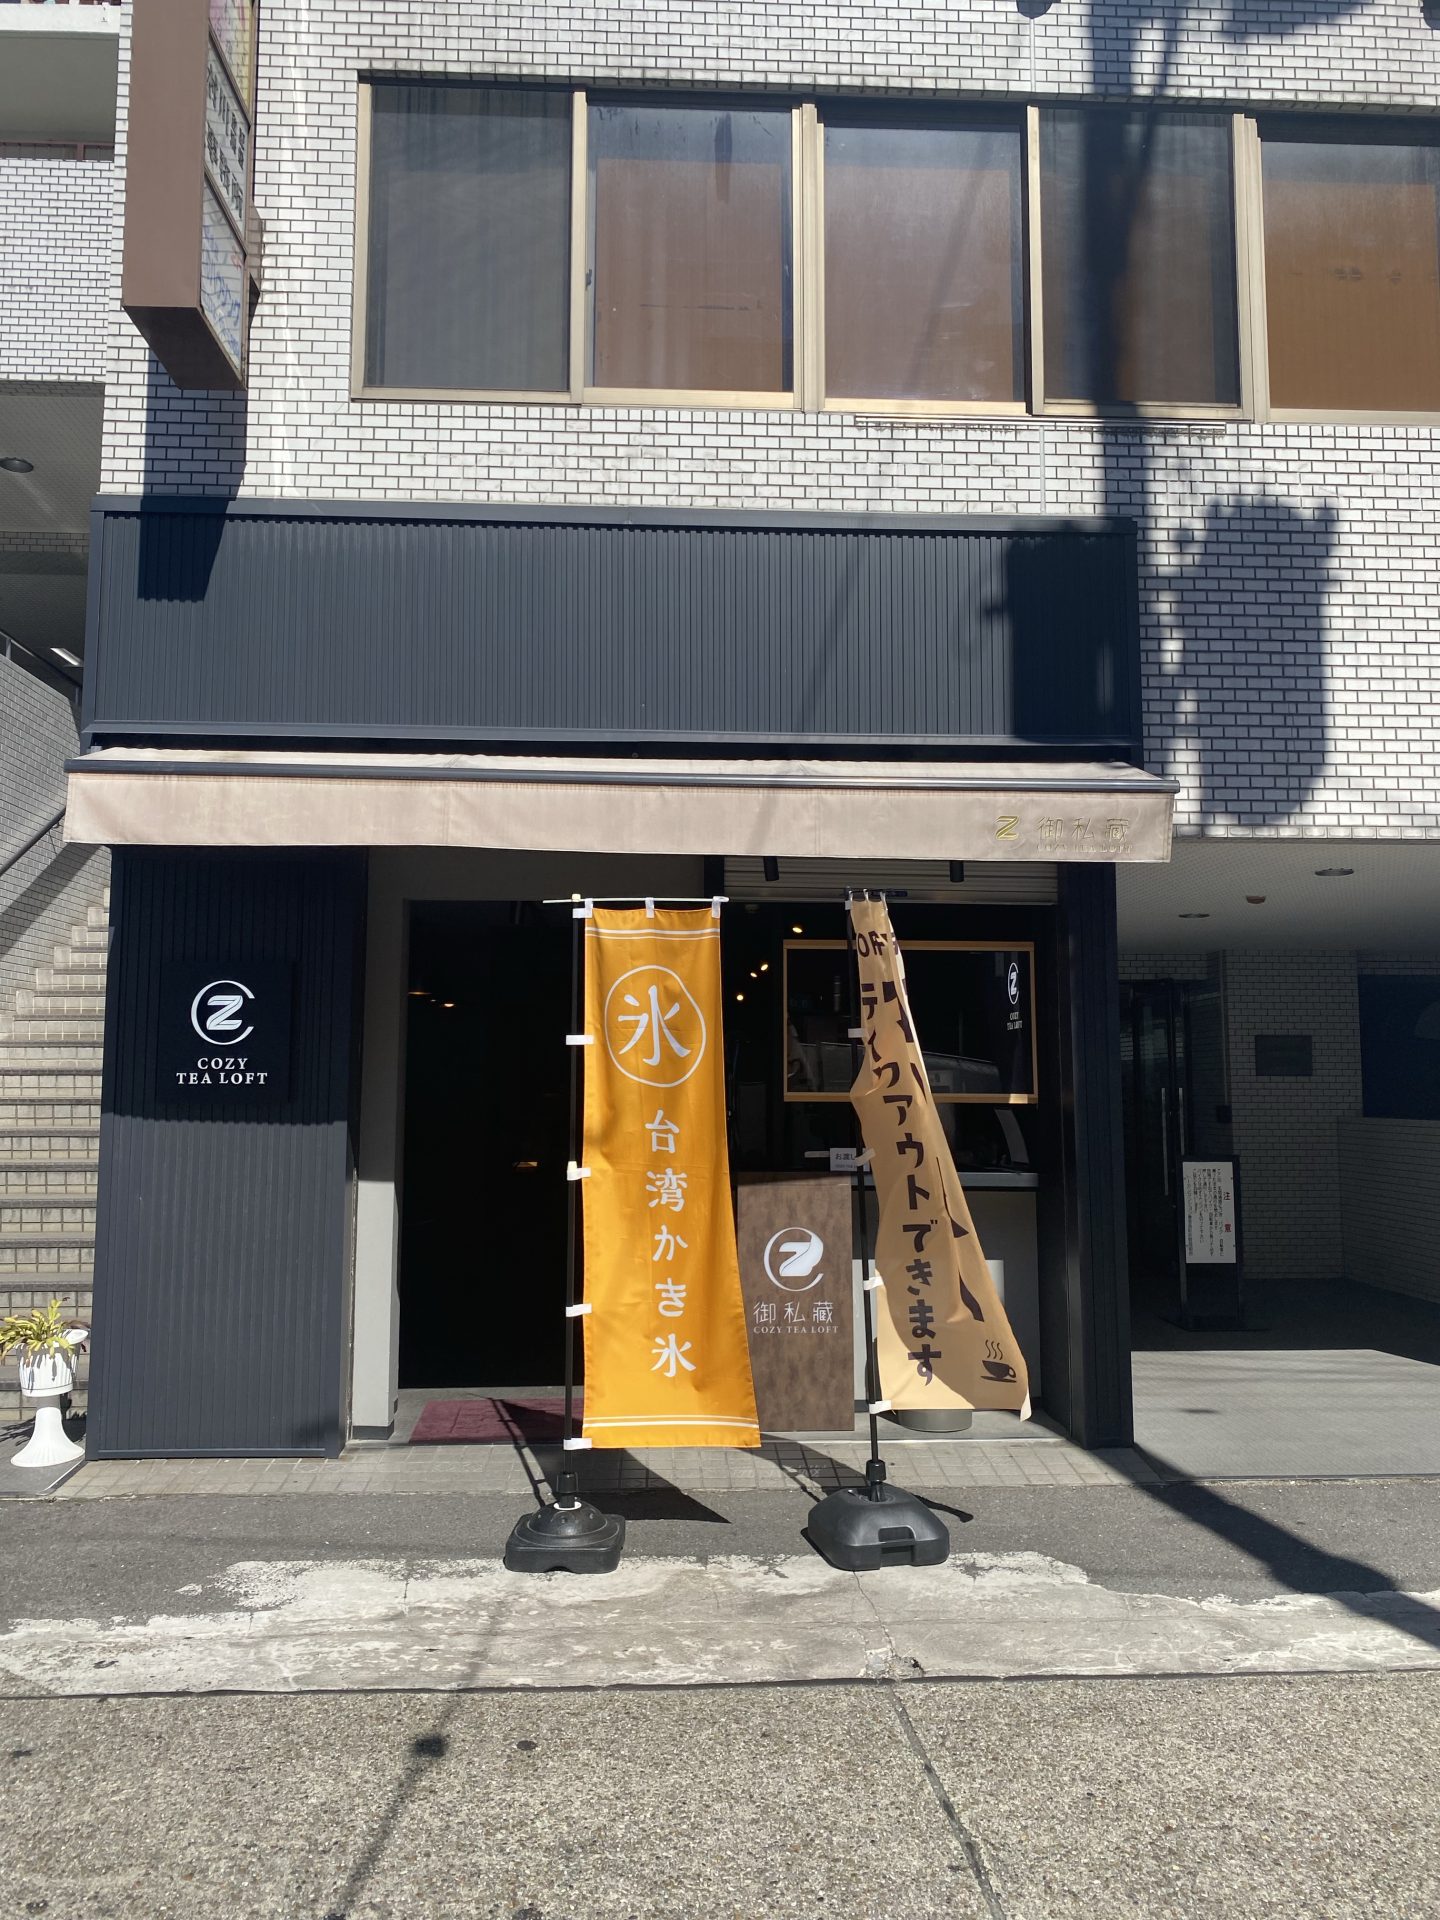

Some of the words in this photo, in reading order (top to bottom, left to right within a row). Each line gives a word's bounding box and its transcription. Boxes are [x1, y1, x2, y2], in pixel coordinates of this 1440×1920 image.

[617, 984, 691, 1066] 氷
[197, 1058, 248, 1070] COZY
[176, 1072, 212, 1085] TEA
[219, 1072, 268, 1085] LOFT
[835, 1153, 857, 1161] お渡し
[645, 1109, 696, 1378] 台湾かき氷
[753, 1301, 834, 1324] 御私藏
[753, 1326, 782, 1334] COZY
[786, 1326, 807, 1334] TEA
[811, 1326, 839, 1334] LOFT
